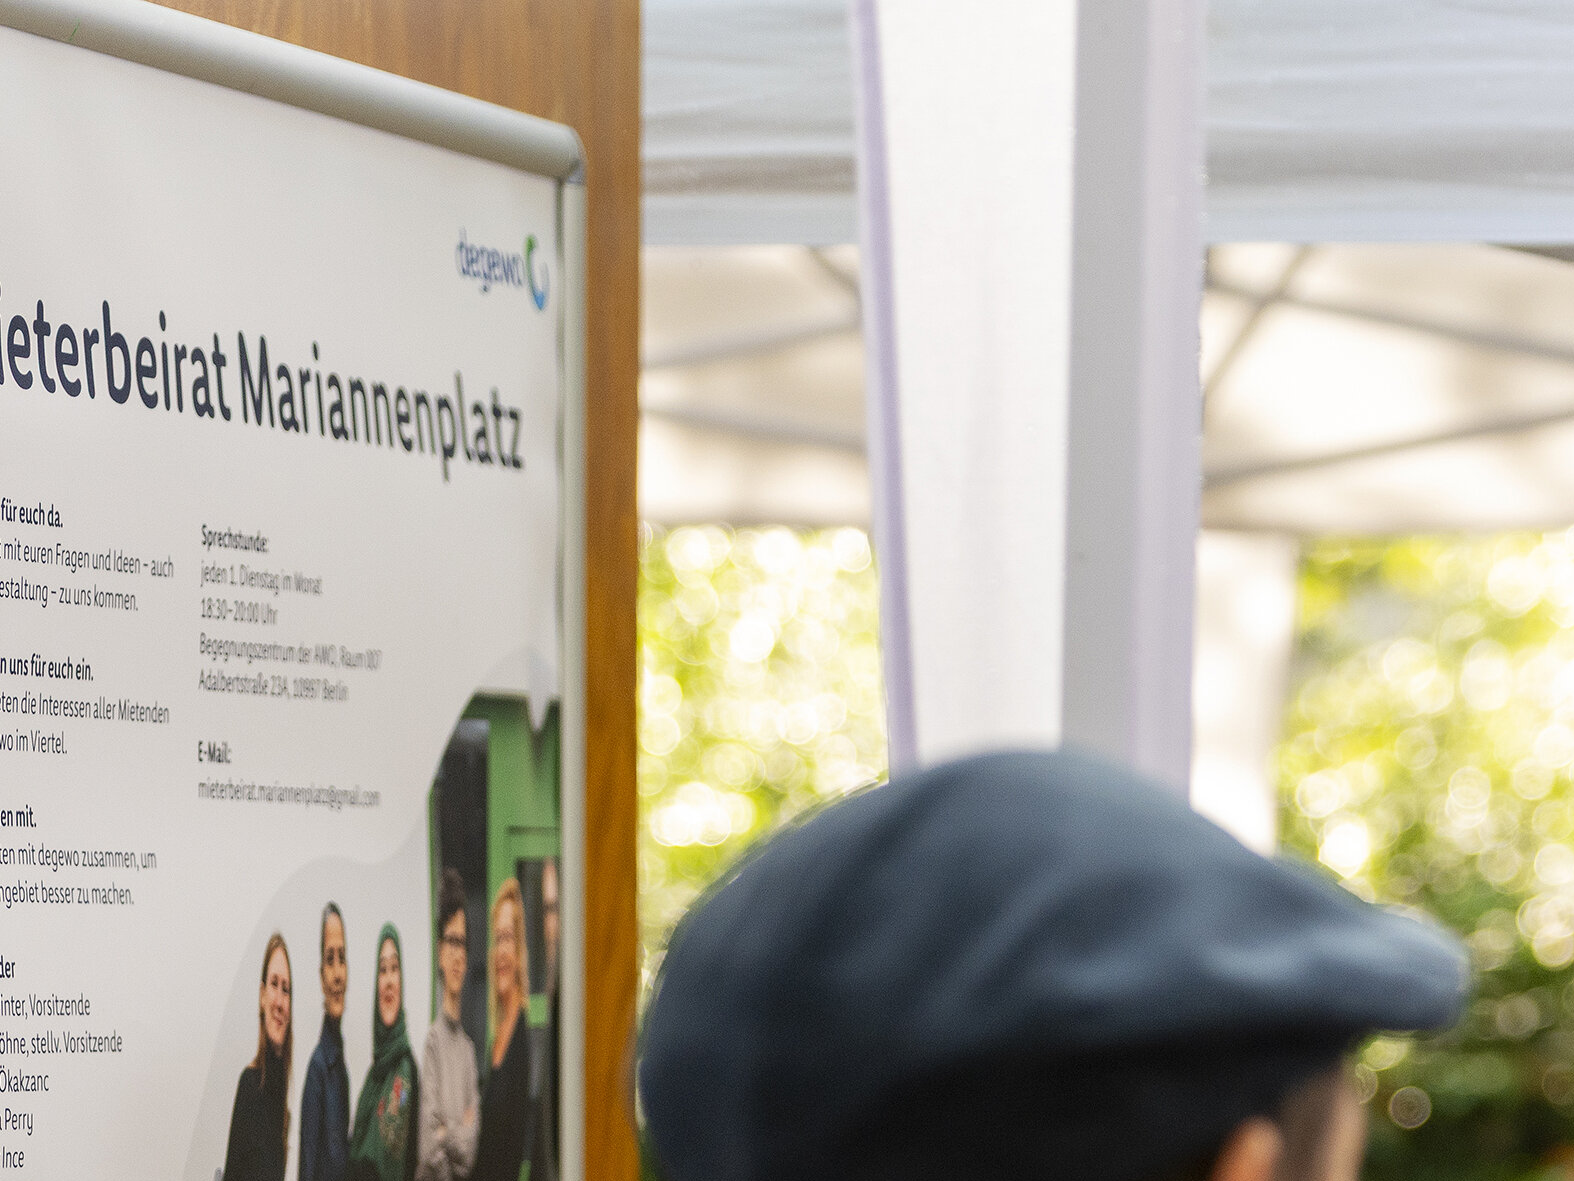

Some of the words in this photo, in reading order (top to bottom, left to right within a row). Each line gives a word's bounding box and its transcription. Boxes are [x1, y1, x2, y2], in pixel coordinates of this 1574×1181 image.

[456, 225, 525, 294] degewo
[237, 329, 525, 483] Mariannenplatz
[1, 496, 17, 522] für
[19, 502, 45, 525] euch
[48, 503, 63, 528] da.
[201, 523, 269, 553] Sprechstunde:
[4, 538, 21, 561] mit
[24, 546, 53, 564] euren
[56, 543, 90, 573] Fragen
[93, 548, 111, 571] und
[114, 550, 141, 573] Ideen
[151, 555, 174, 577] auch
[200, 560, 228, 587] jeden
[239, 563, 280, 596] Dienstag
[59, 587, 71, 604] zu
[74, 588, 92, 606] uns
[94, 584, 138, 611] kommen.
[261, 601, 278, 625] Uhr
[200, 631, 295, 665] Begegnungszentrum
[297, 641, 312, 664] der
[9, 658, 28, 676] uns
[31, 653, 46, 677] für
[49, 656, 73, 680] euch
[76, 658, 94, 681] ein.
[198, 668, 269, 695] Adalbertstraße
[322, 677, 349, 701] Berlin
[21, 691, 36, 715] die
[39, 693, 91, 718] Interessen
[93, 696, 116, 720] aller
[118, 699, 169, 723] Mietenden
[16, 729, 28, 752] im
[30, 730, 67, 754] Viertel.
[198, 740, 232, 764] E-Mail:
[16, 804, 37, 828] mit.
[18, 843, 36, 866] mit
[38, 843, 79, 872] degewo
[82, 850, 140, 871] zusammen,
[141, 852, 157, 869] um
[41, 880, 74, 904] besser
[77, 887, 90, 904] zu
[92, 882, 134, 905] machen.
[29, 992, 91, 1016] Vorsitzende
[31, 1030, 61, 1054] stellv.
[63, 1029, 122, 1053] Vorsitzende
[4, 1108, 33, 1136] Perry
[2, 1146, 24, 1168] Ince
